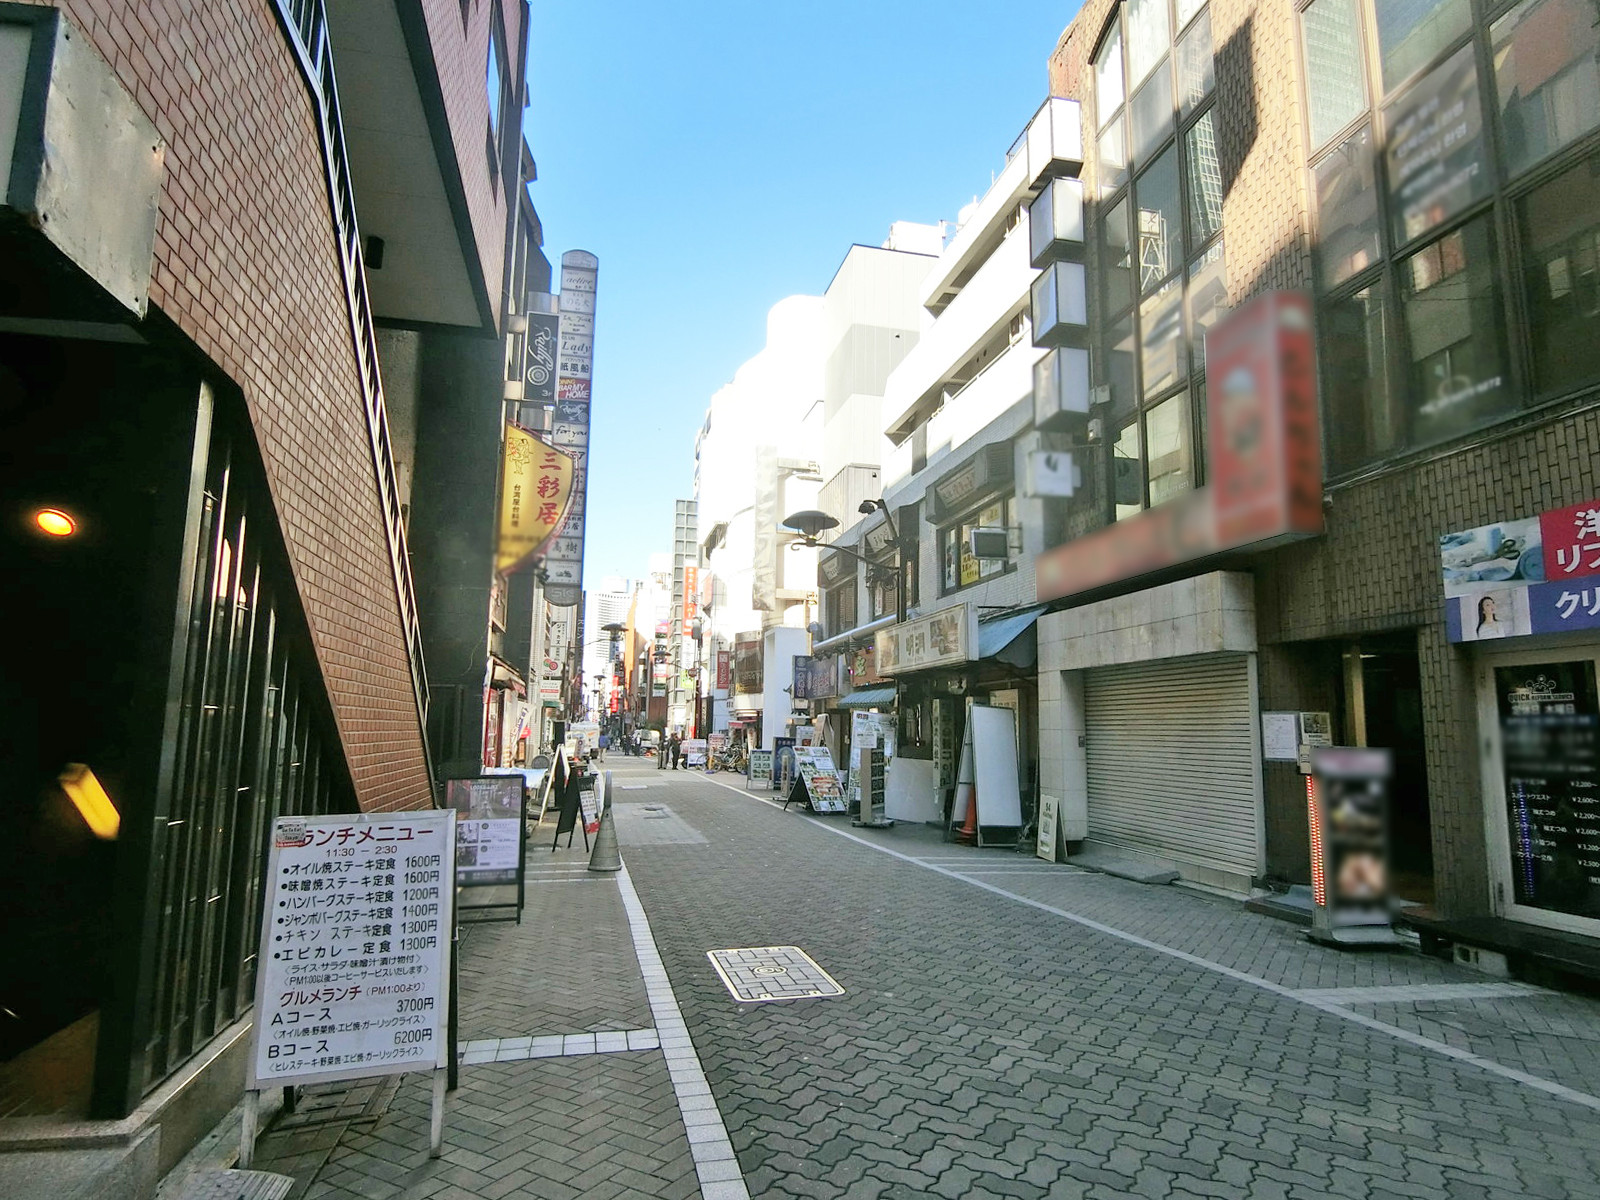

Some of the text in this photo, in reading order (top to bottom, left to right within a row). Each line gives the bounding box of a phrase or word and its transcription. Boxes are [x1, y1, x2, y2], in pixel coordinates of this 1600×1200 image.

[561, 341, 591, 354] Lady
[565, 390, 590, 398] HOME
[534, 452, 562, 526] 三彩居
[299, 826, 434, 848] ランチメニュー
[325, 848, 355, 857] 11:30
[375, 846, 398, 855] 2:30
[290, 855, 441, 876] オイル焼ステーキ定食 1600円
[288, 870, 440, 891] 味噌焼ステーキ定食 1600円
[286, 887, 439, 909] ハンバーグステーキ定食 1200円
[284, 903, 438, 927] ジャンボバーグステーキ定食 1400円
[283, 920, 438, 943] チキン ステーキ定食 1300円
[399, 936, 437, 951] 1300円
[280, 985, 362, 1008] グルメランチ
[271, 997, 434, 1026] Aコース 3700円
[268, 1027, 432, 1059] Bコース 6200円
